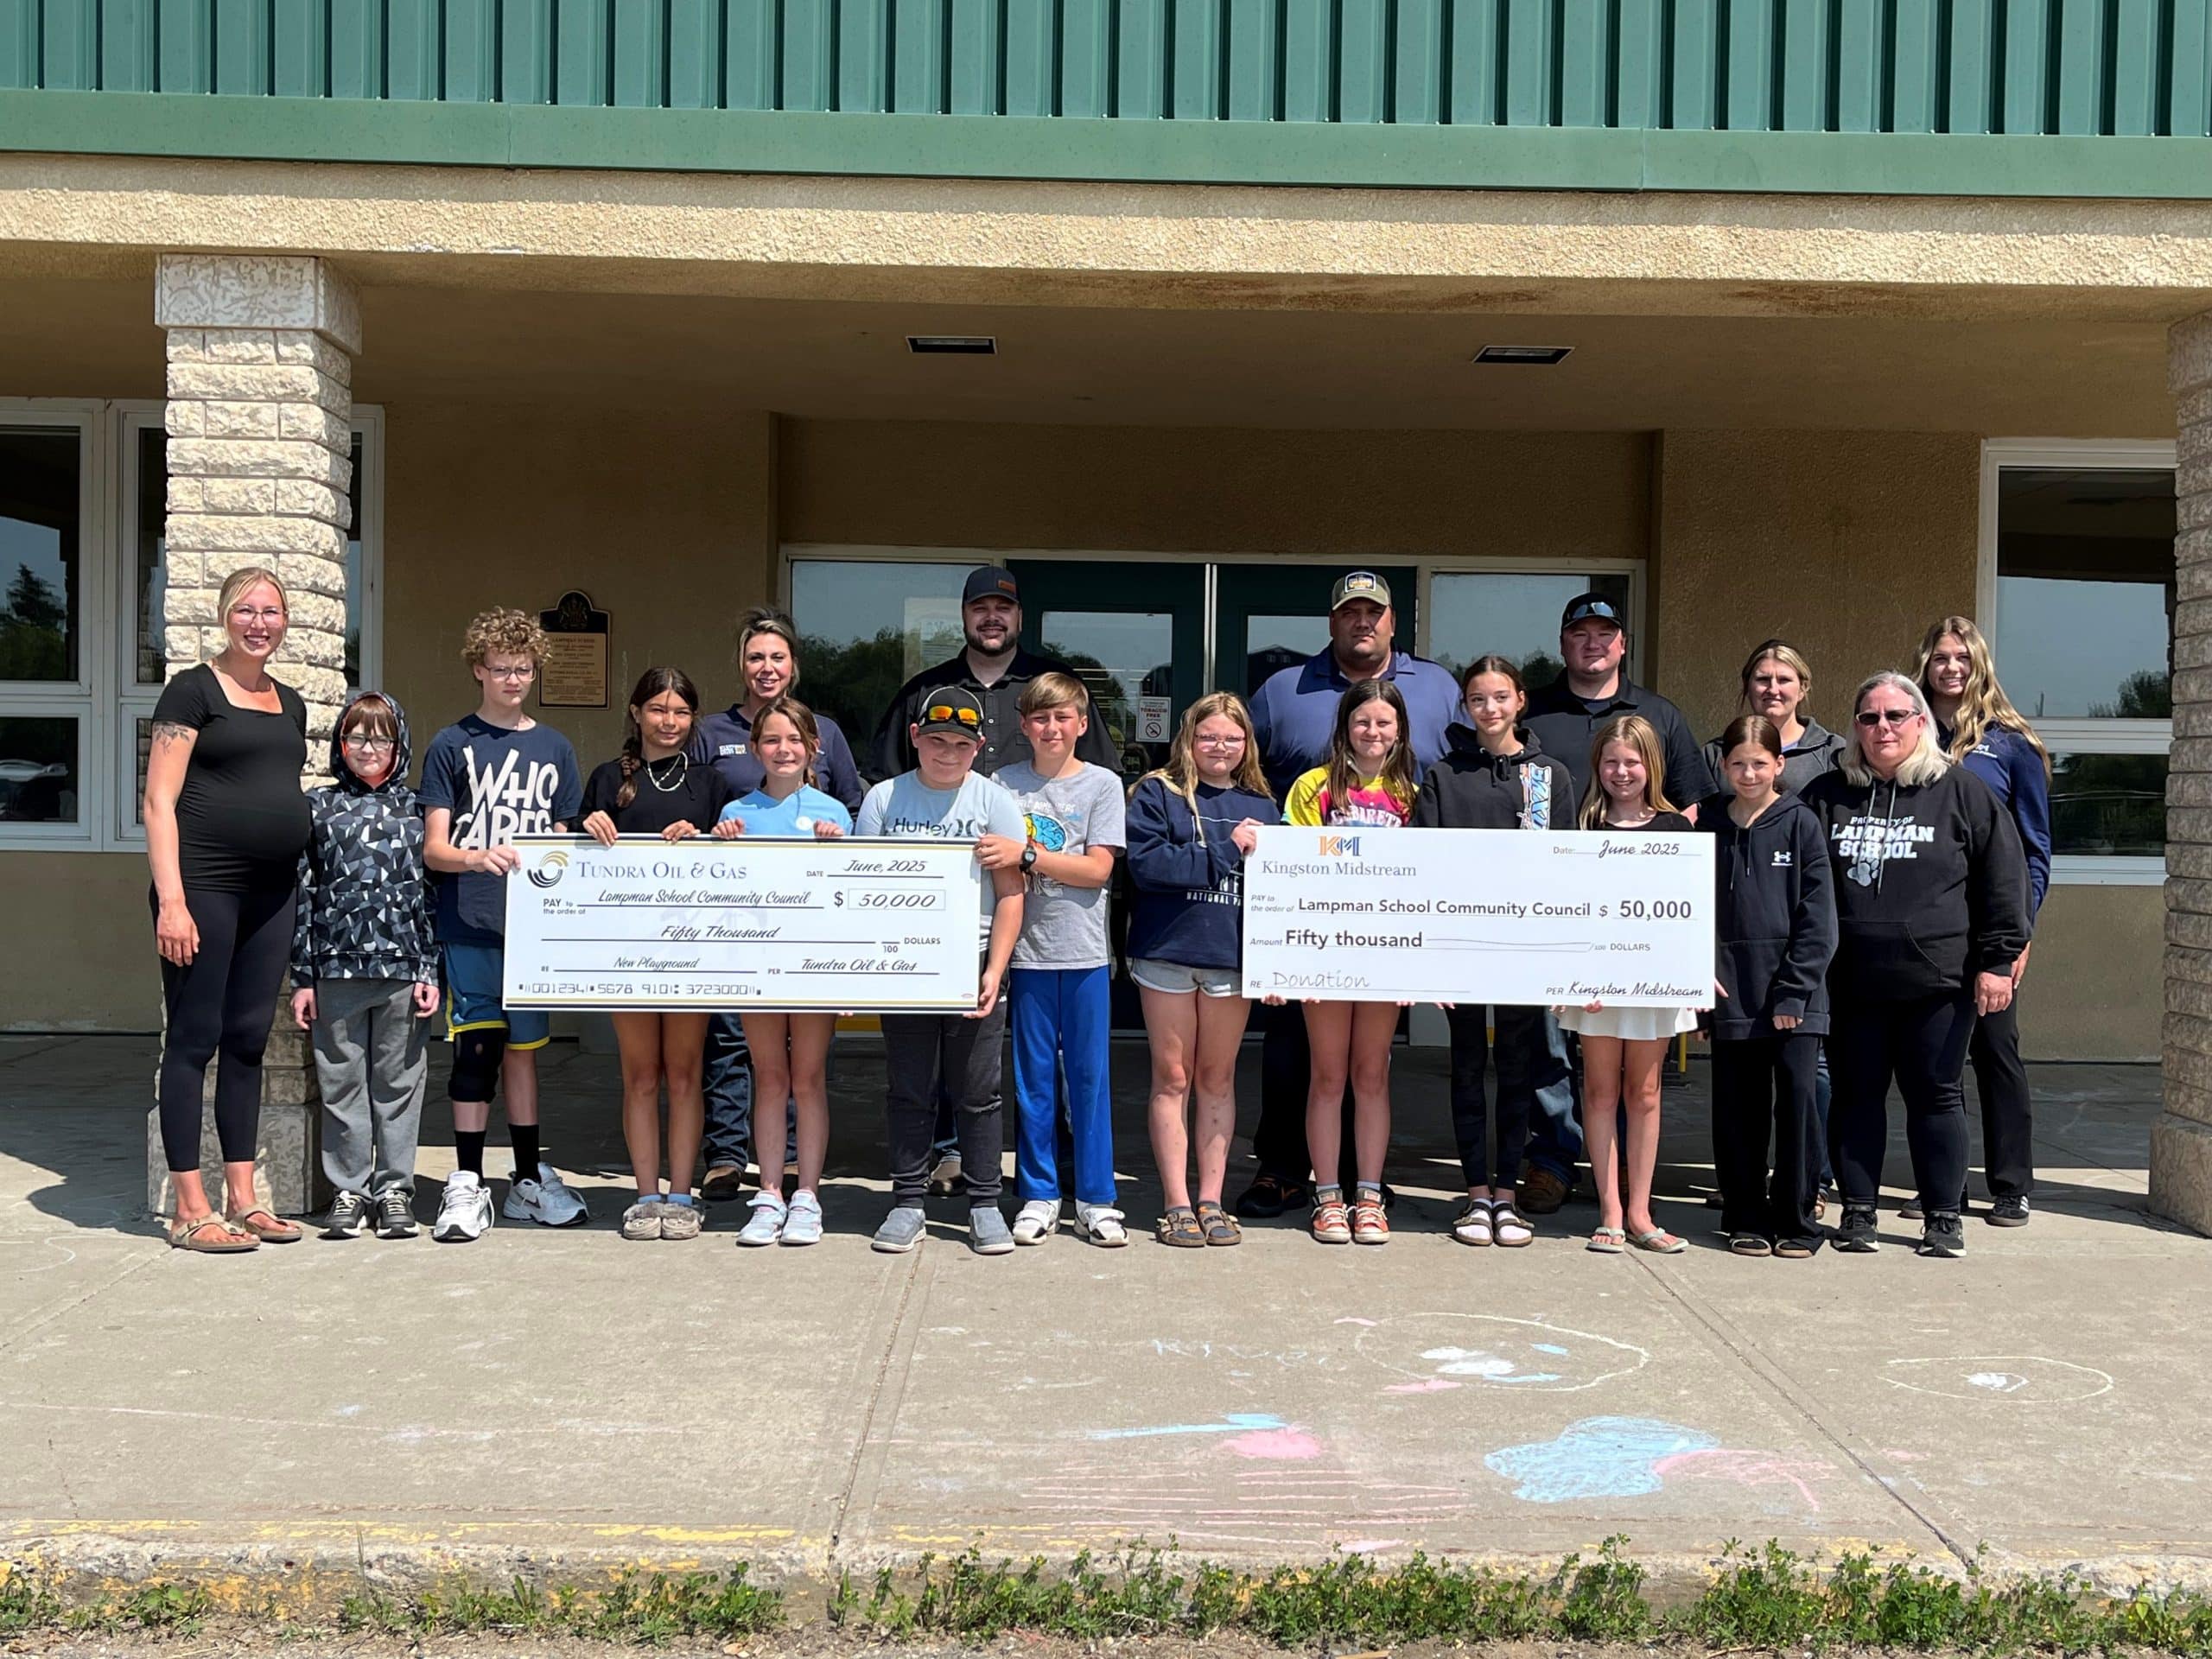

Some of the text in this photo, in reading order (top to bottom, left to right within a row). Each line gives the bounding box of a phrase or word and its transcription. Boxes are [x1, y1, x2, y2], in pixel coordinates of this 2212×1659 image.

[462, 745, 559, 814] WHO
[1599, 840, 1636, 858] June
[1641, 842, 1680, 855] 2025
[691, 862, 706, 879] &
[843, 860, 926, 873] June, 2025
[1262, 861, 1417, 877] Kingston Midstream
[543, 899, 562, 907] PAY
[598, 889, 936, 910] Lampman School Community Council $ 50,000
[1186, 892, 1229, 905] NATIONAL
[1299, 898, 1692, 921] Lampman School Community Council $ 50,000
[661, 925, 781, 940] Fifty Thousand
[1249, 938, 1283, 946] Amount
[1286, 930, 1329, 950] Fifty
[1336, 931, 1422, 948] thousand
[1610, 943, 1650, 951] DOLLARS
[613, 957, 634, 969] New
[637, 957, 700, 971] Playground
[801, 958, 847, 971] Tundra
[850, 958, 875, 971] Oil
[876, 960, 888, 971] &
[892, 960, 918, 971] Gas
[1272, 969, 1370, 988] Donation
[1568, 982, 1627, 998] Kingston
[1630, 982, 1704, 997] Midstream
